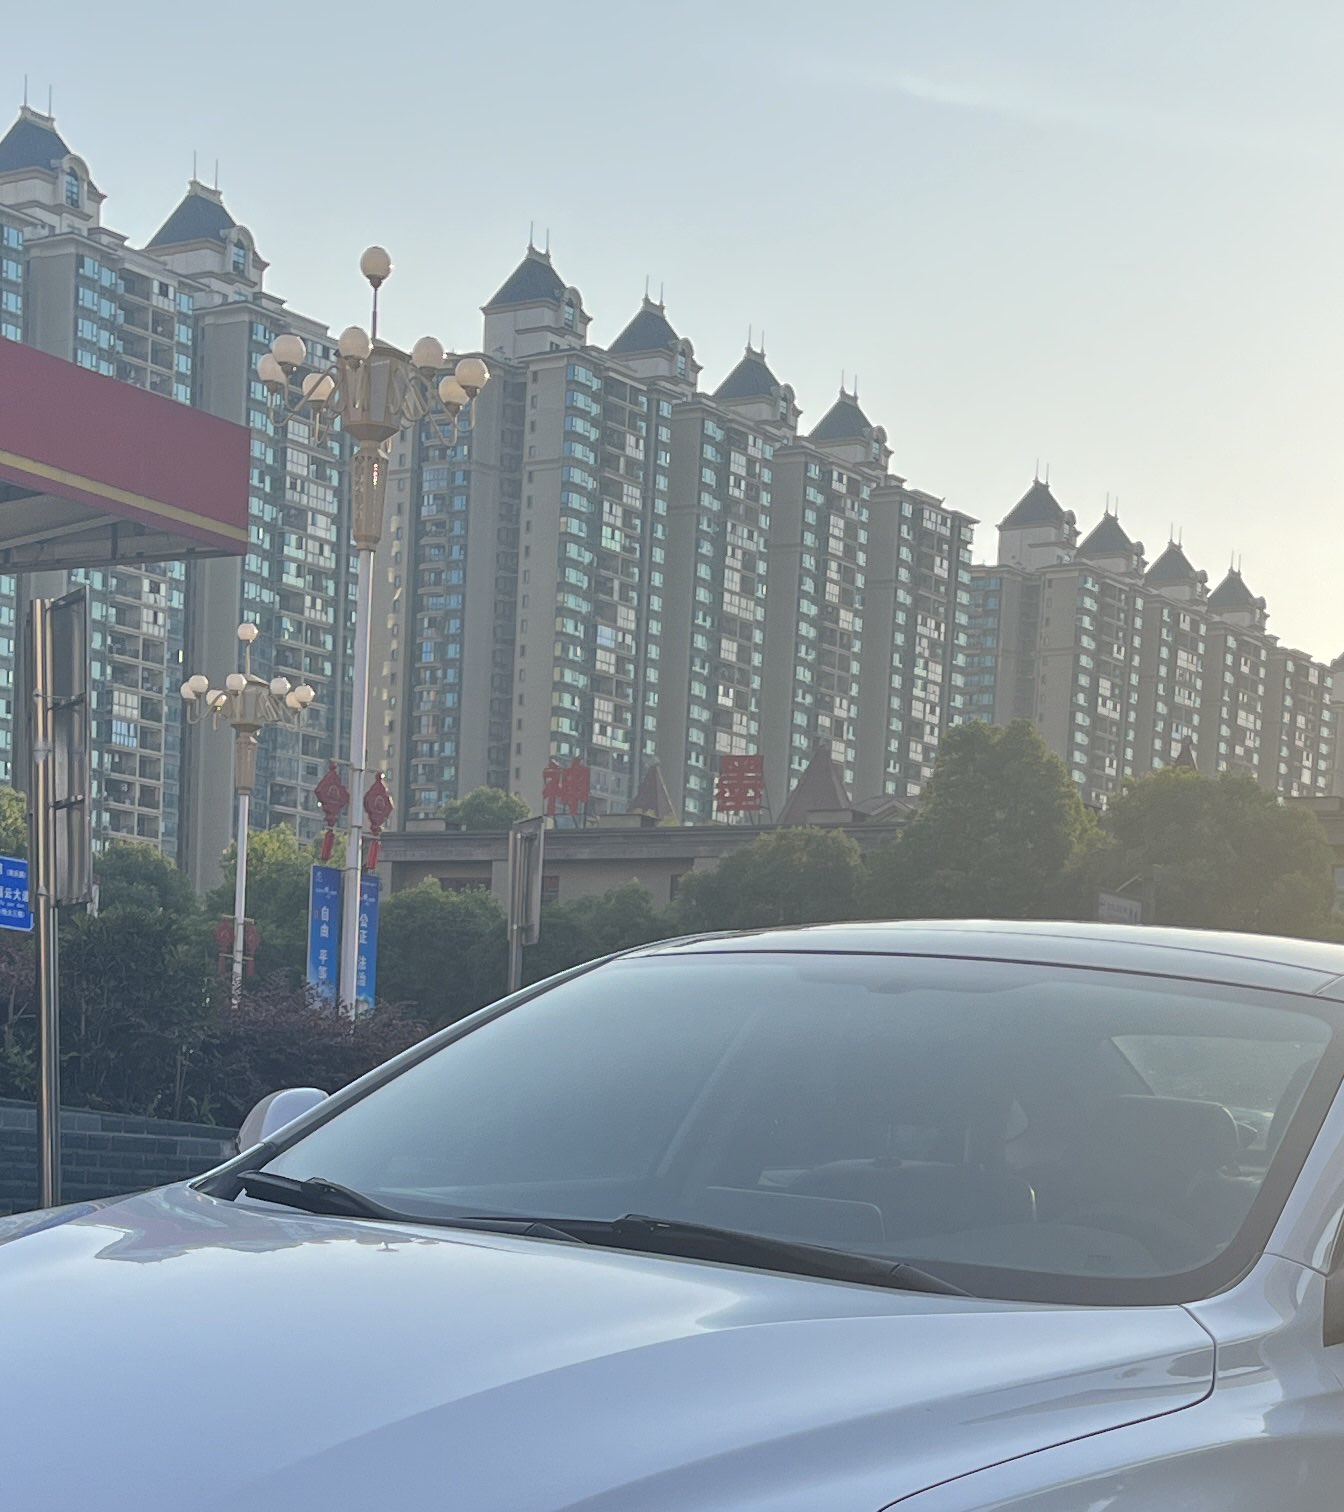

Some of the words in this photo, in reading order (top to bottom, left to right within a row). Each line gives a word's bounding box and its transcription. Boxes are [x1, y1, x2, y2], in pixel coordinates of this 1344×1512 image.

[320, 905, 329, 937] 自由
[359, 913, 368, 943] 公正
[318, 949, 328, 979] 平等
